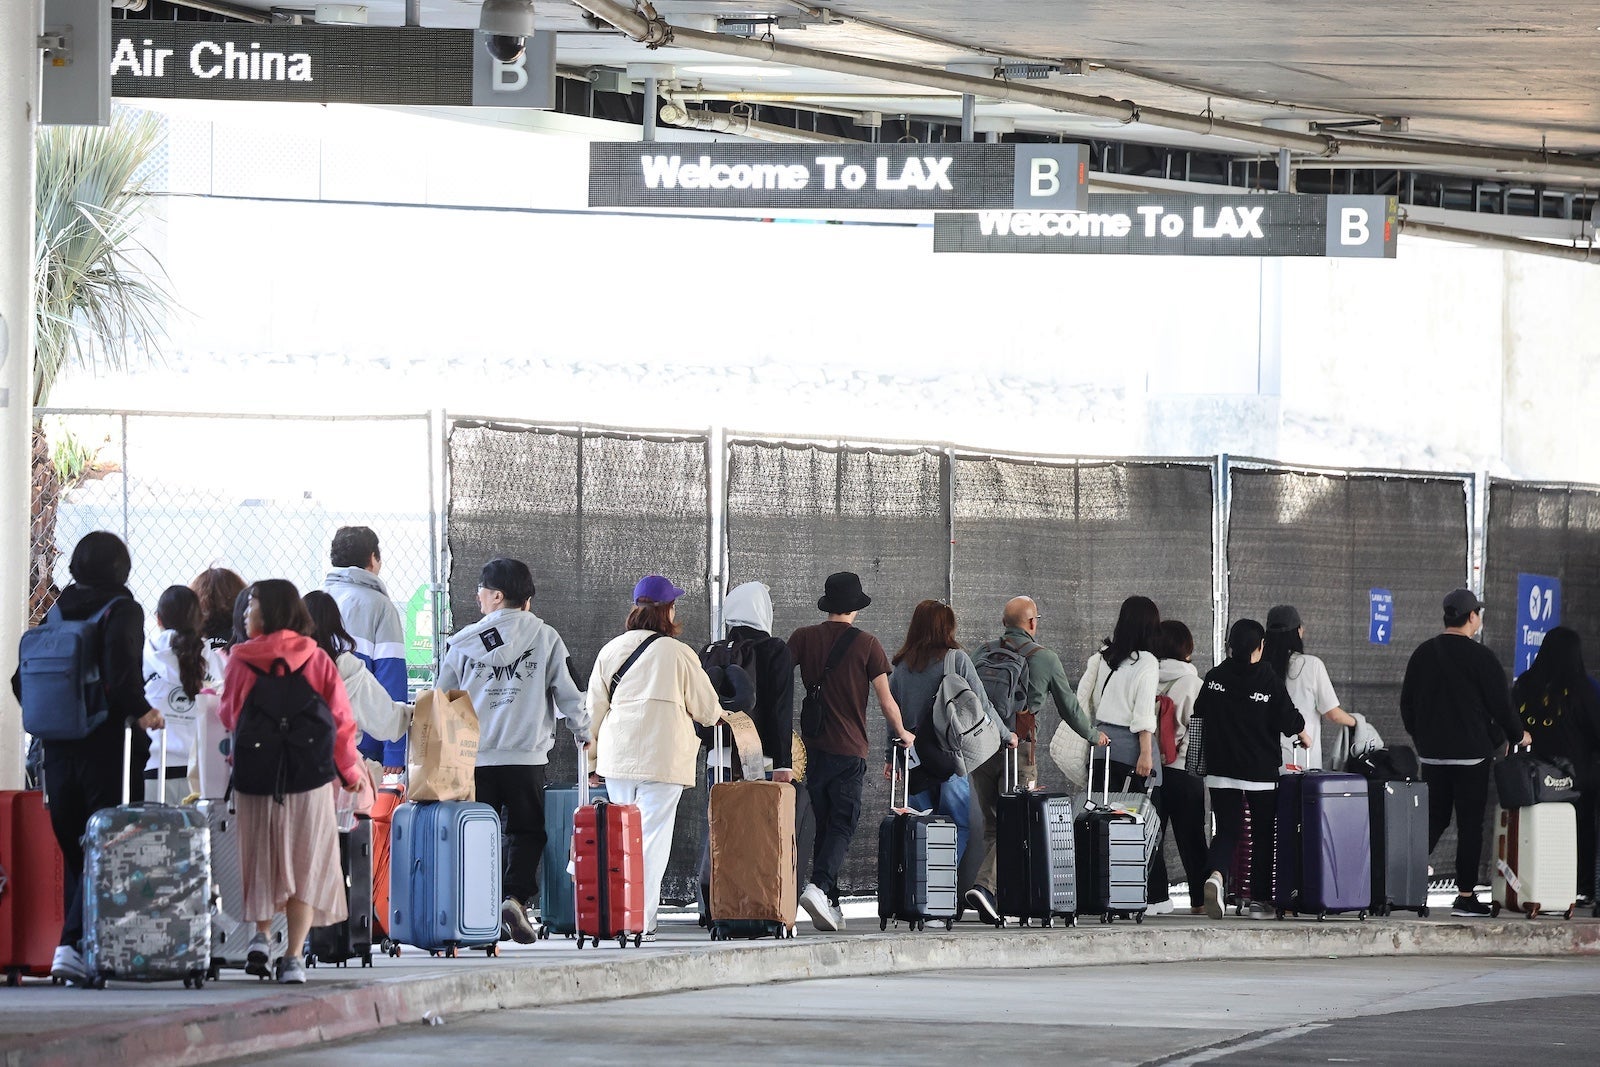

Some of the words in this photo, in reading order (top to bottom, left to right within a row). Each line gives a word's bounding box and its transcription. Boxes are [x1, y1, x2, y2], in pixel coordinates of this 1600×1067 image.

[109, 38, 174, 77] Air
[189, 41, 314, 82] China
[492, 52, 528, 91] B
[640, 155, 809, 190] Welcome
[815, 156, 867, 190] To
[876, 156, 954, 190] LAX
[1030, 157, 1061, 197] B
[978, 210, 1132, 237] Welcome
[1137, 205, 1185, 238] To
[1193, 206, 1265, 238] LAX
[1340, 207, 1370, 246] B
[524, 661, 538, 670] LIFE
